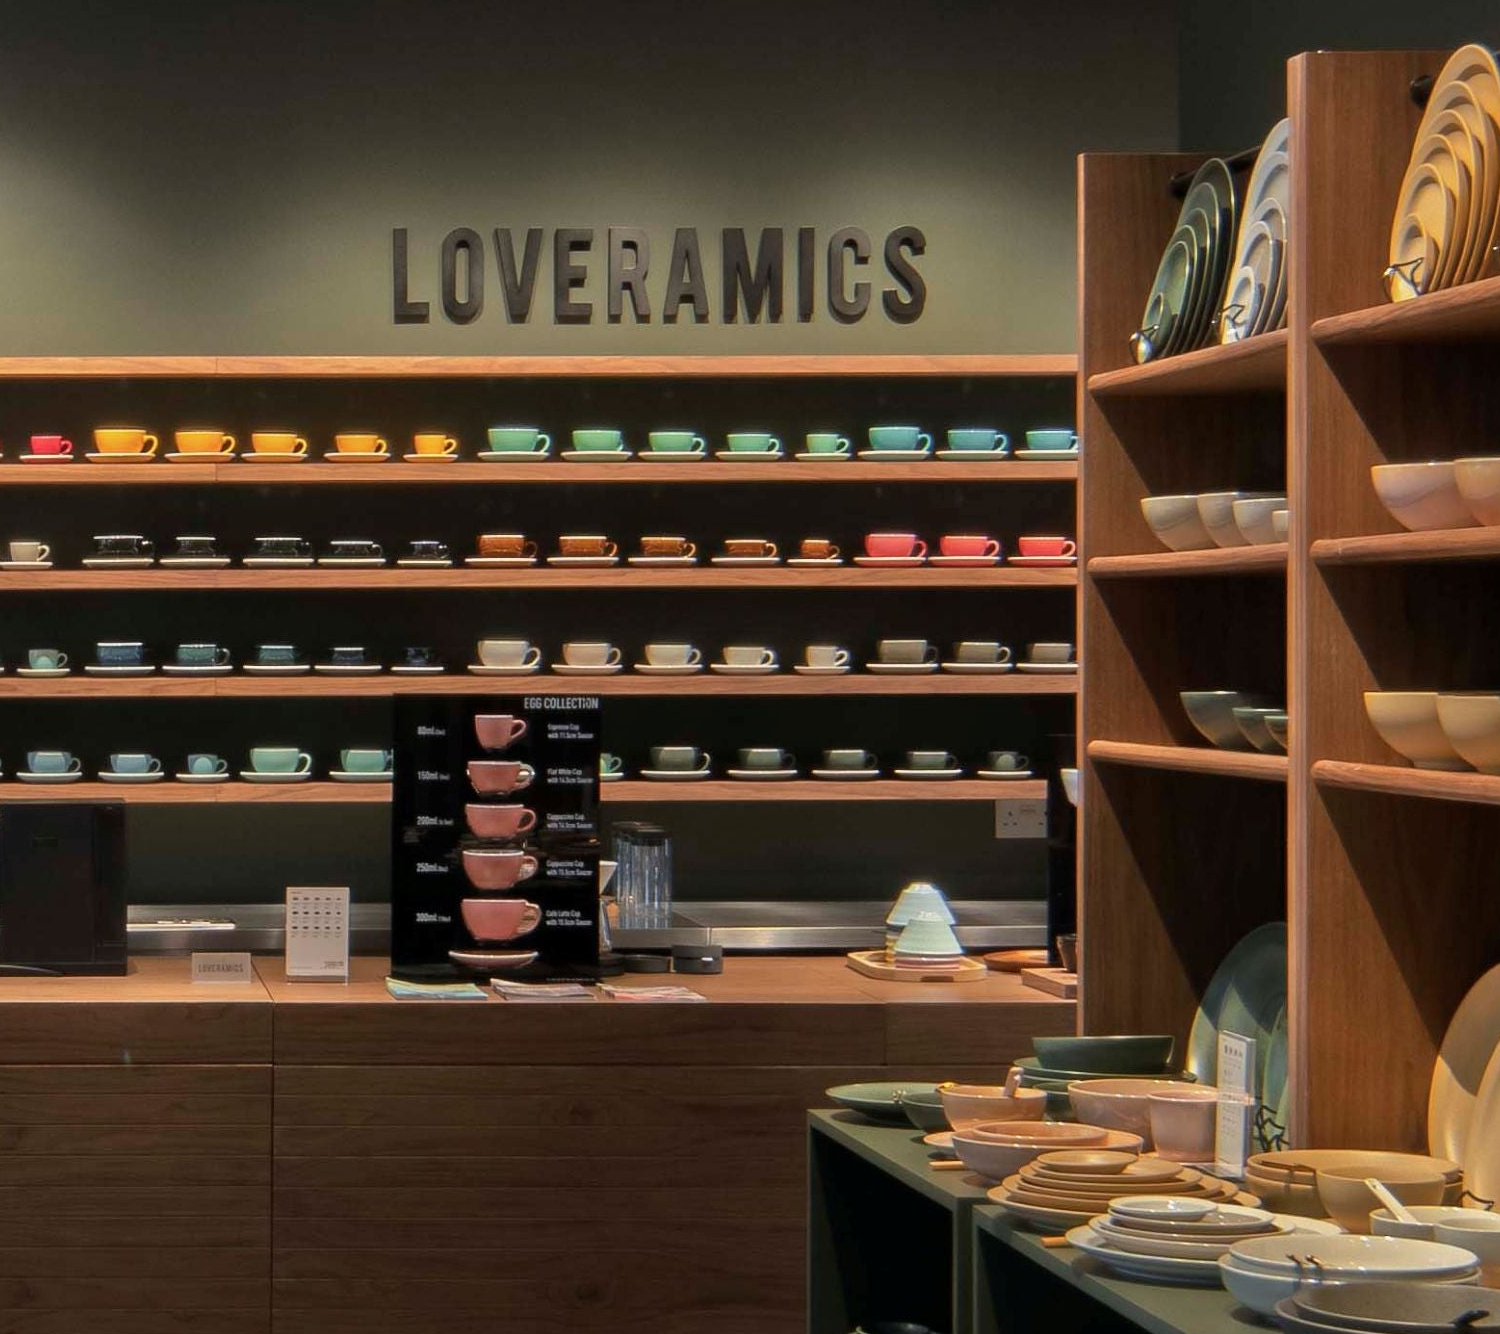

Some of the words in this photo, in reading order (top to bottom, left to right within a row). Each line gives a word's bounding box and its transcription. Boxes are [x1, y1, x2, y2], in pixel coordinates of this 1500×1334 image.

[392, 226, 927, 324] LOVERAMICS
[524, 697, 542, 709] EGG
[544, 697, 599, 709] COLLECTION
